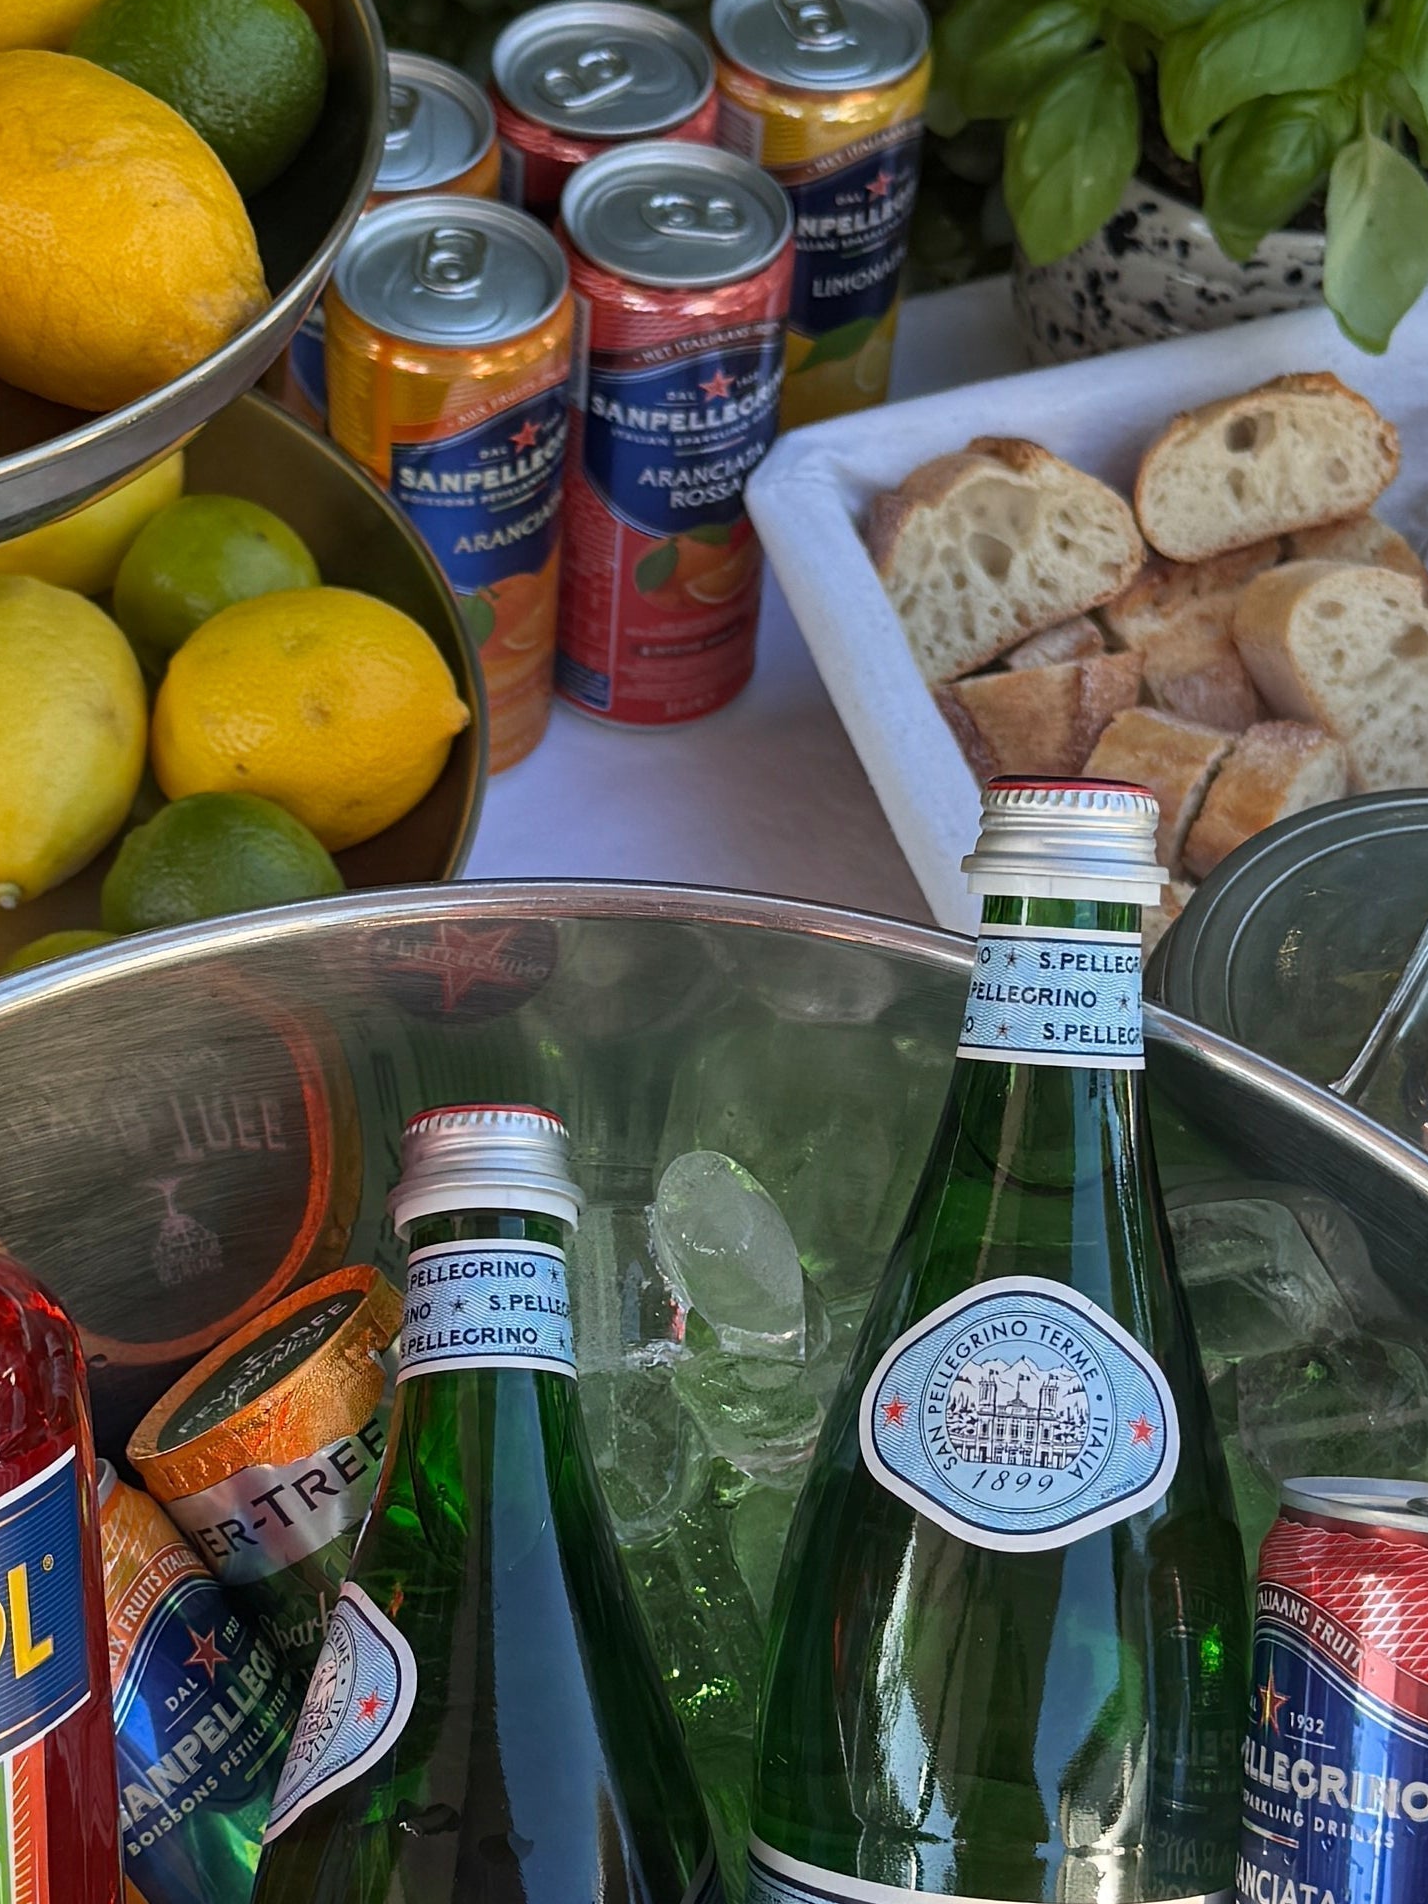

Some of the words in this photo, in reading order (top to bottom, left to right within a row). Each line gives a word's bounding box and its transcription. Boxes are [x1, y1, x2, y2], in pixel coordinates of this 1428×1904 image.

[927, 1319, 1028, 1415] PELLEGRINO
[1038, 1323, 1099, 1383] TERME
[927, 1426, 959, 1472] SAN
[1067, 1416, 1109, 1481] ITALIA
[971, 1468, 1054, 1496] 1899
[125, 1572, 162, 1634] FRUITS
[1311, 1617, 1364, 1670] FRUIT
[164, 1677, 200, 1713] DAL
[1288, 1711, 1325, 1735] 1932
[126, 1775, 219, 1856] BOISSONS
